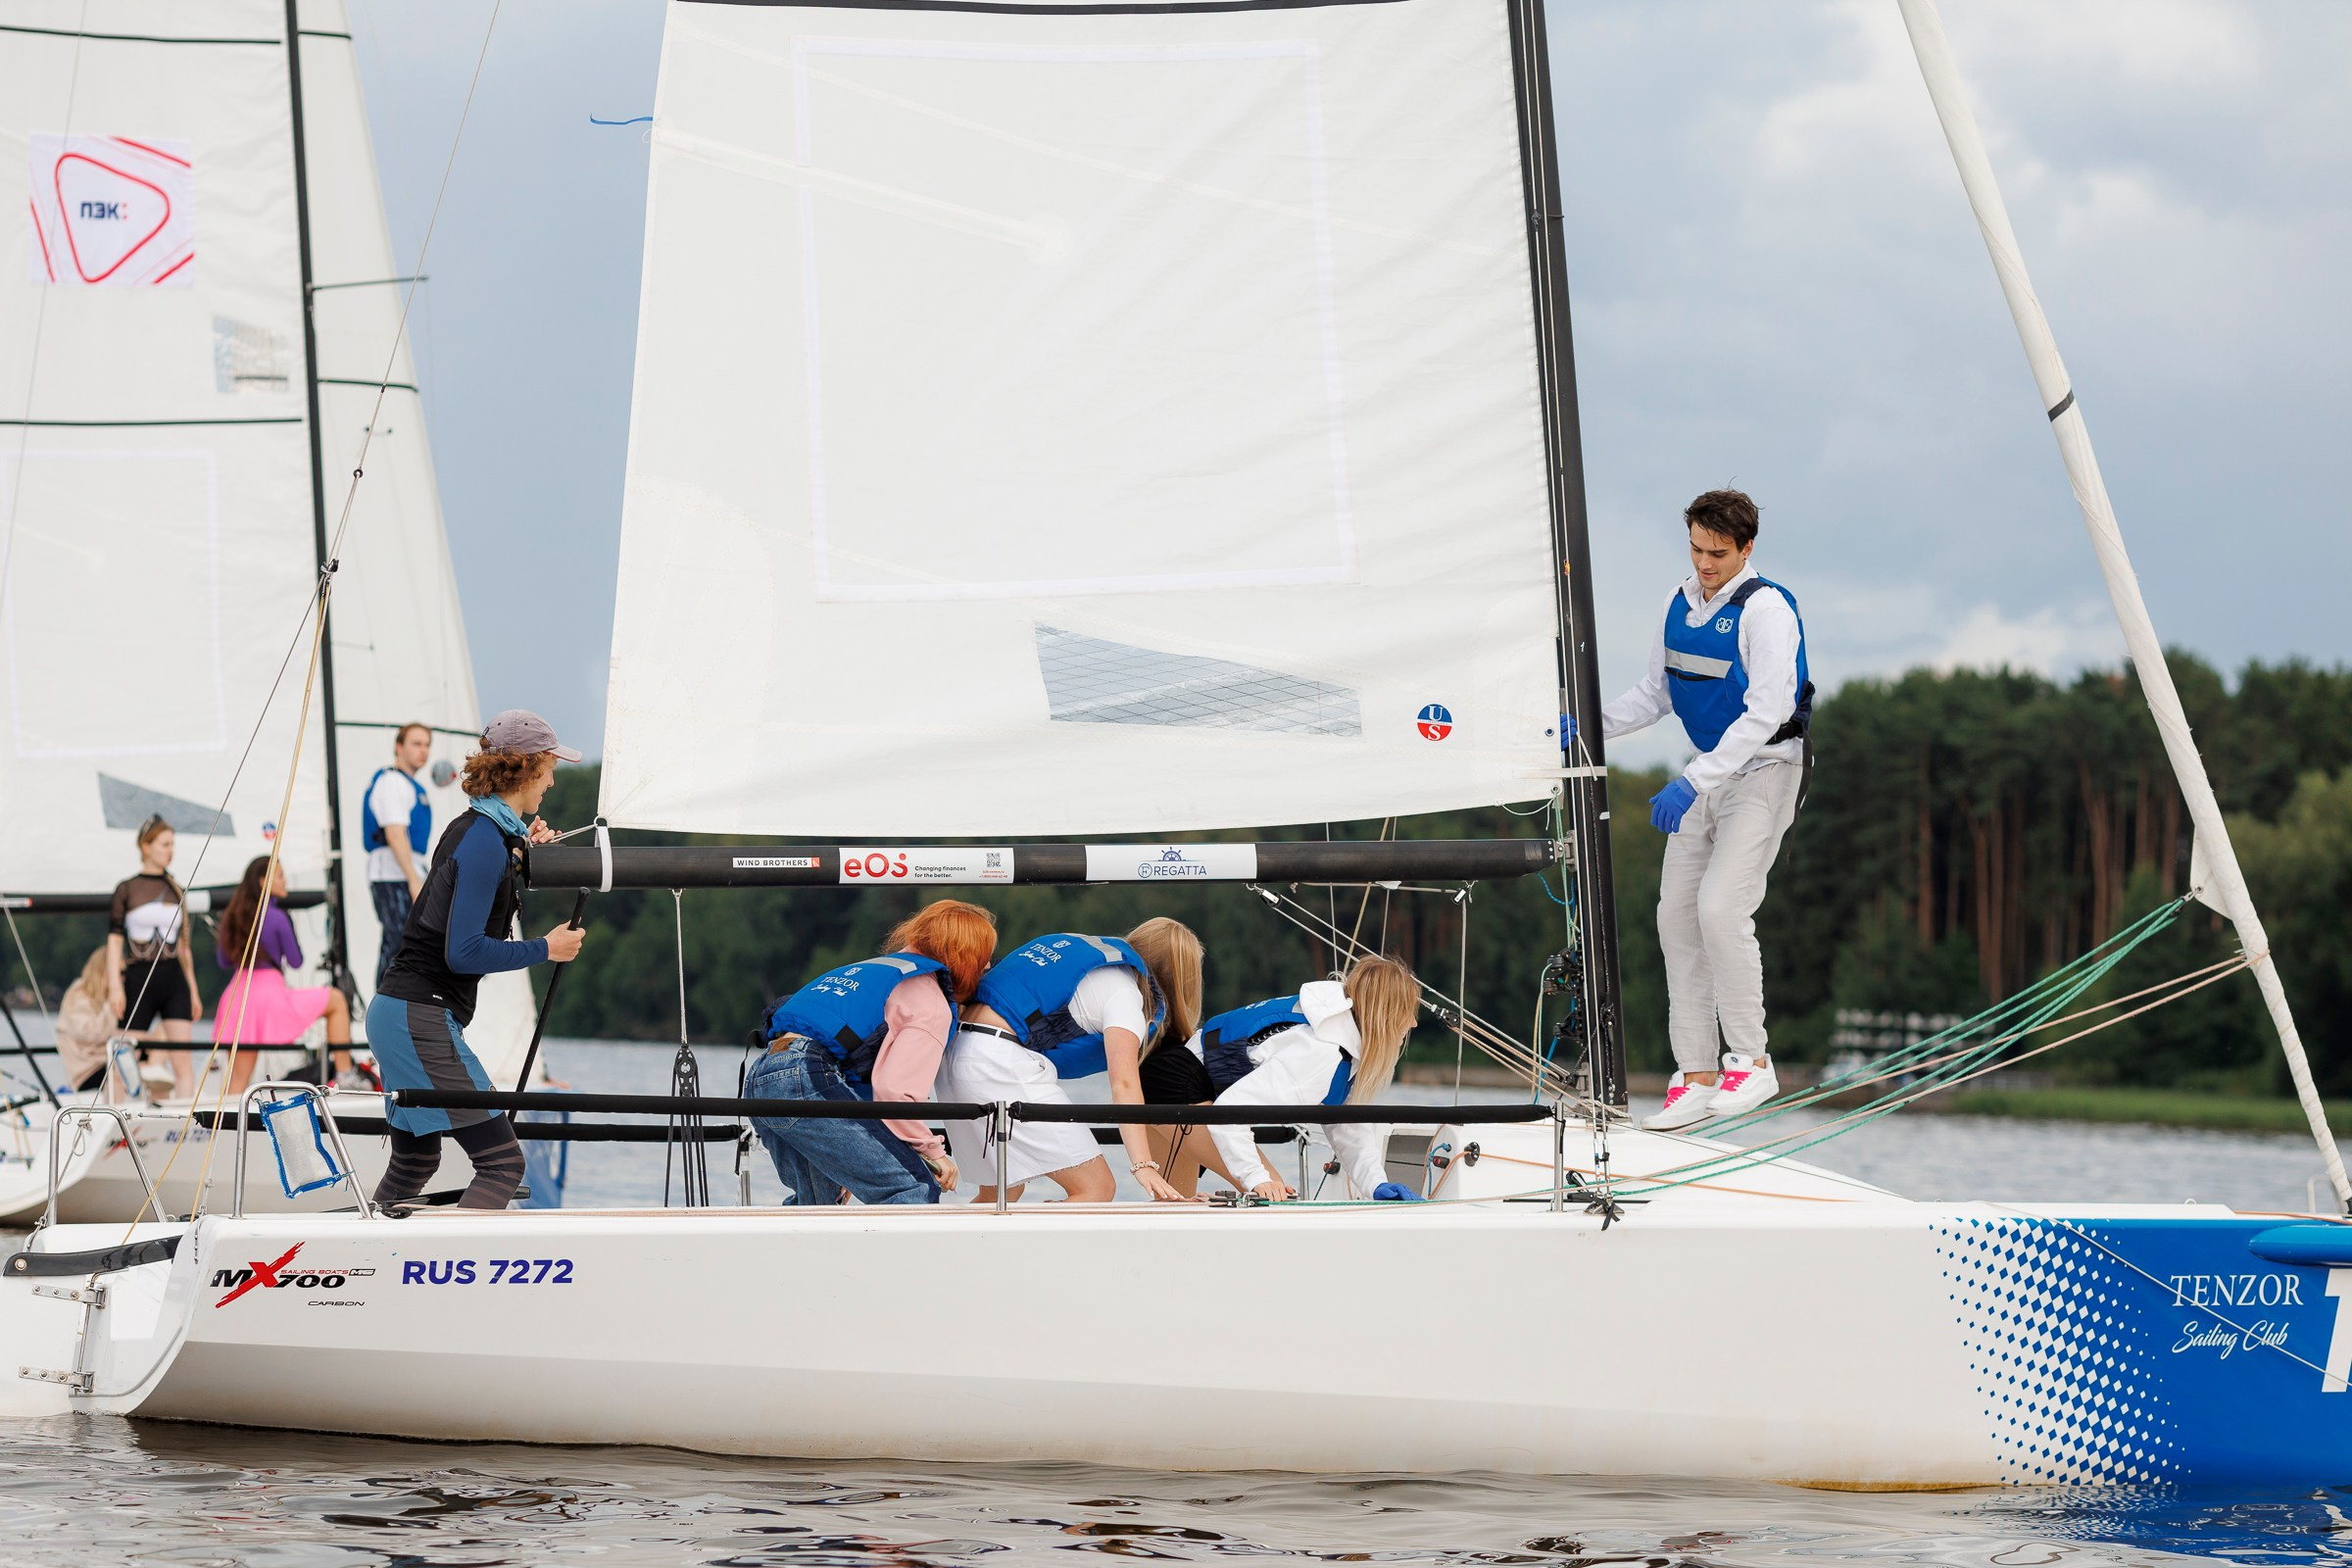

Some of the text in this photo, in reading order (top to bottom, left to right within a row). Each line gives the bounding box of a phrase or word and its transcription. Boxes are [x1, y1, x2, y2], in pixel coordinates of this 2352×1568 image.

[1153, 865, 1207, 876] REGATTA
[1030, 943, 1061, 963] TENZOR
[821, 976, 859, 992] TENZOR
[402, 1258, 574, 1285] RUS 7272
[2170, 1274, 2304, 1307] TENZOR
[2172, 1319, 2290, 1360] Sailing Club
